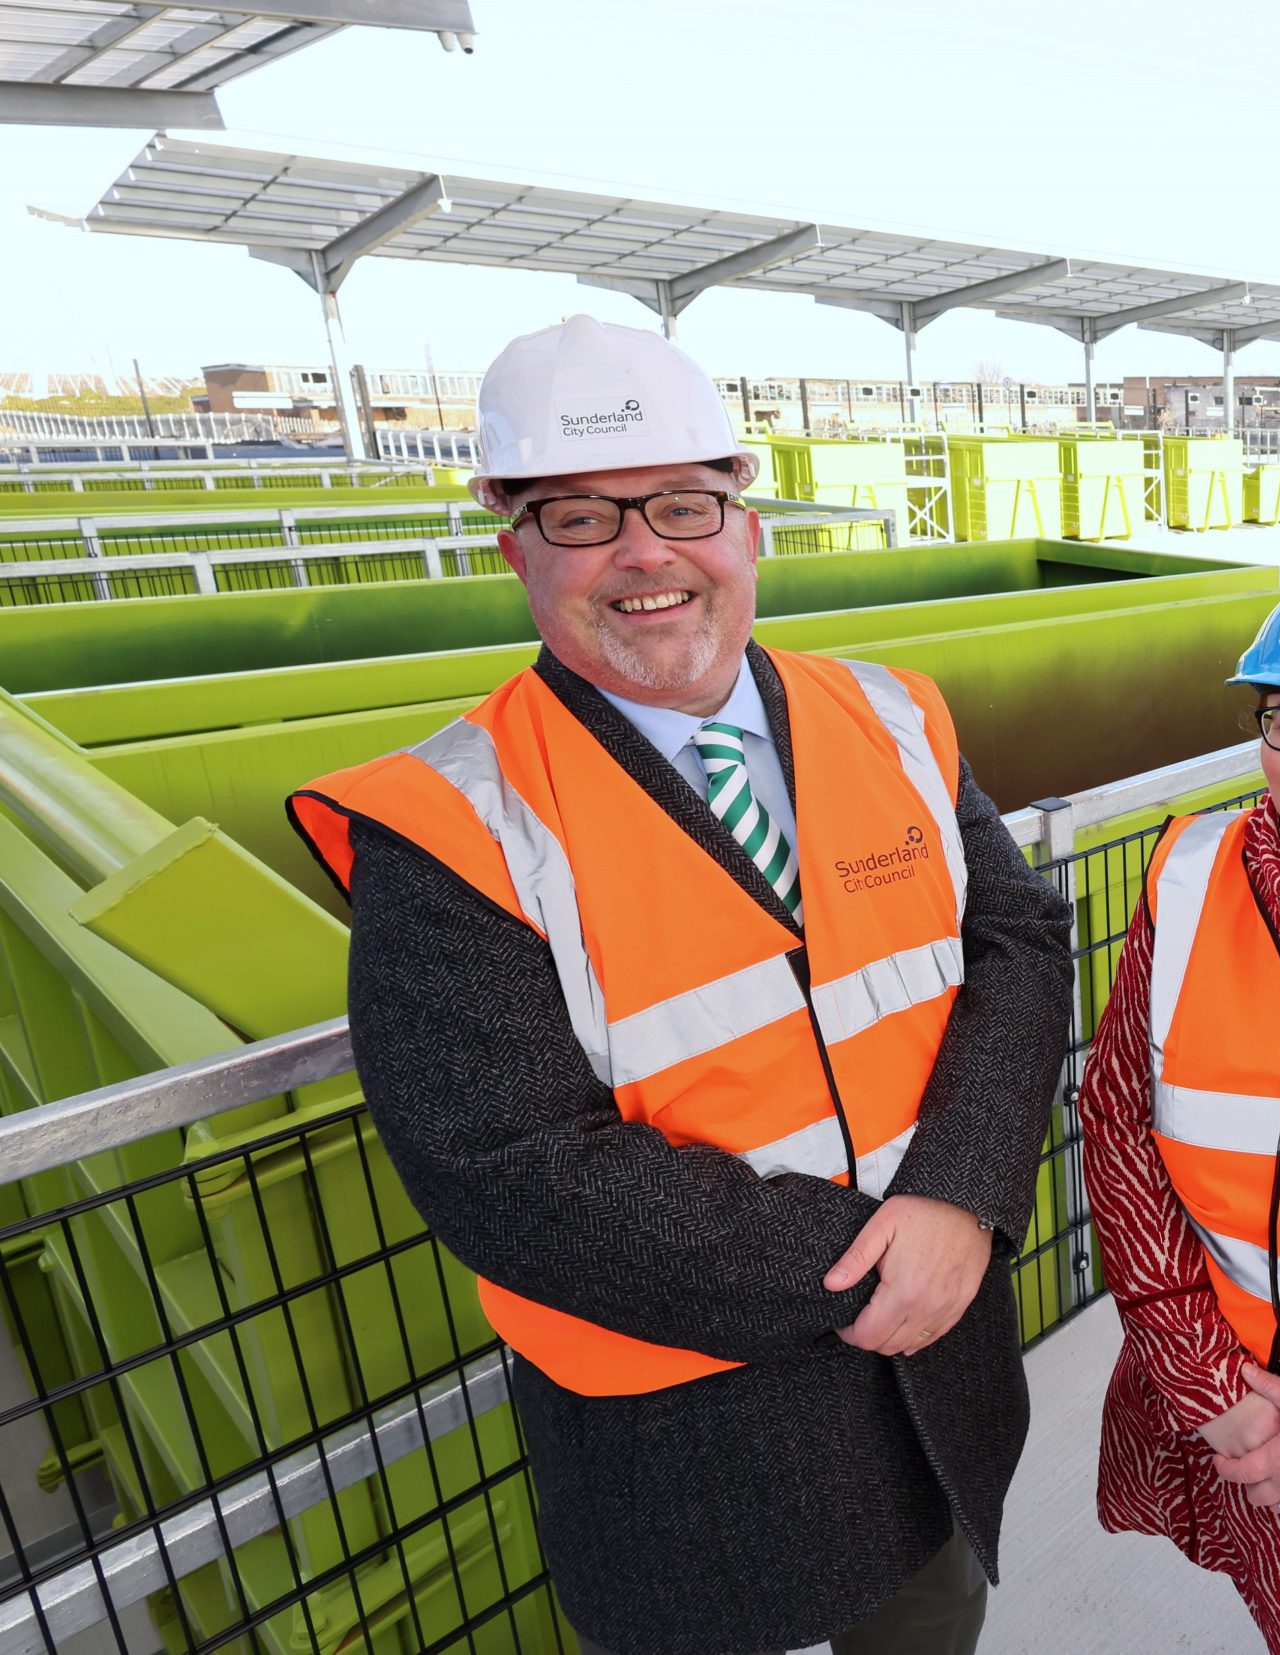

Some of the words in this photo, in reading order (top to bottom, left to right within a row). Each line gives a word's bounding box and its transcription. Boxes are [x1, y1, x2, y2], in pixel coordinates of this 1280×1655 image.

[560, 410, 643, 426] Sunderland
[562, 427, 584, 437] City
[586, 424, 627, 434] Council
[834, 842, 929, 878] Sunderland
[843, 877, 864, 893] Cit
[864, 864, 916, 889] Council
